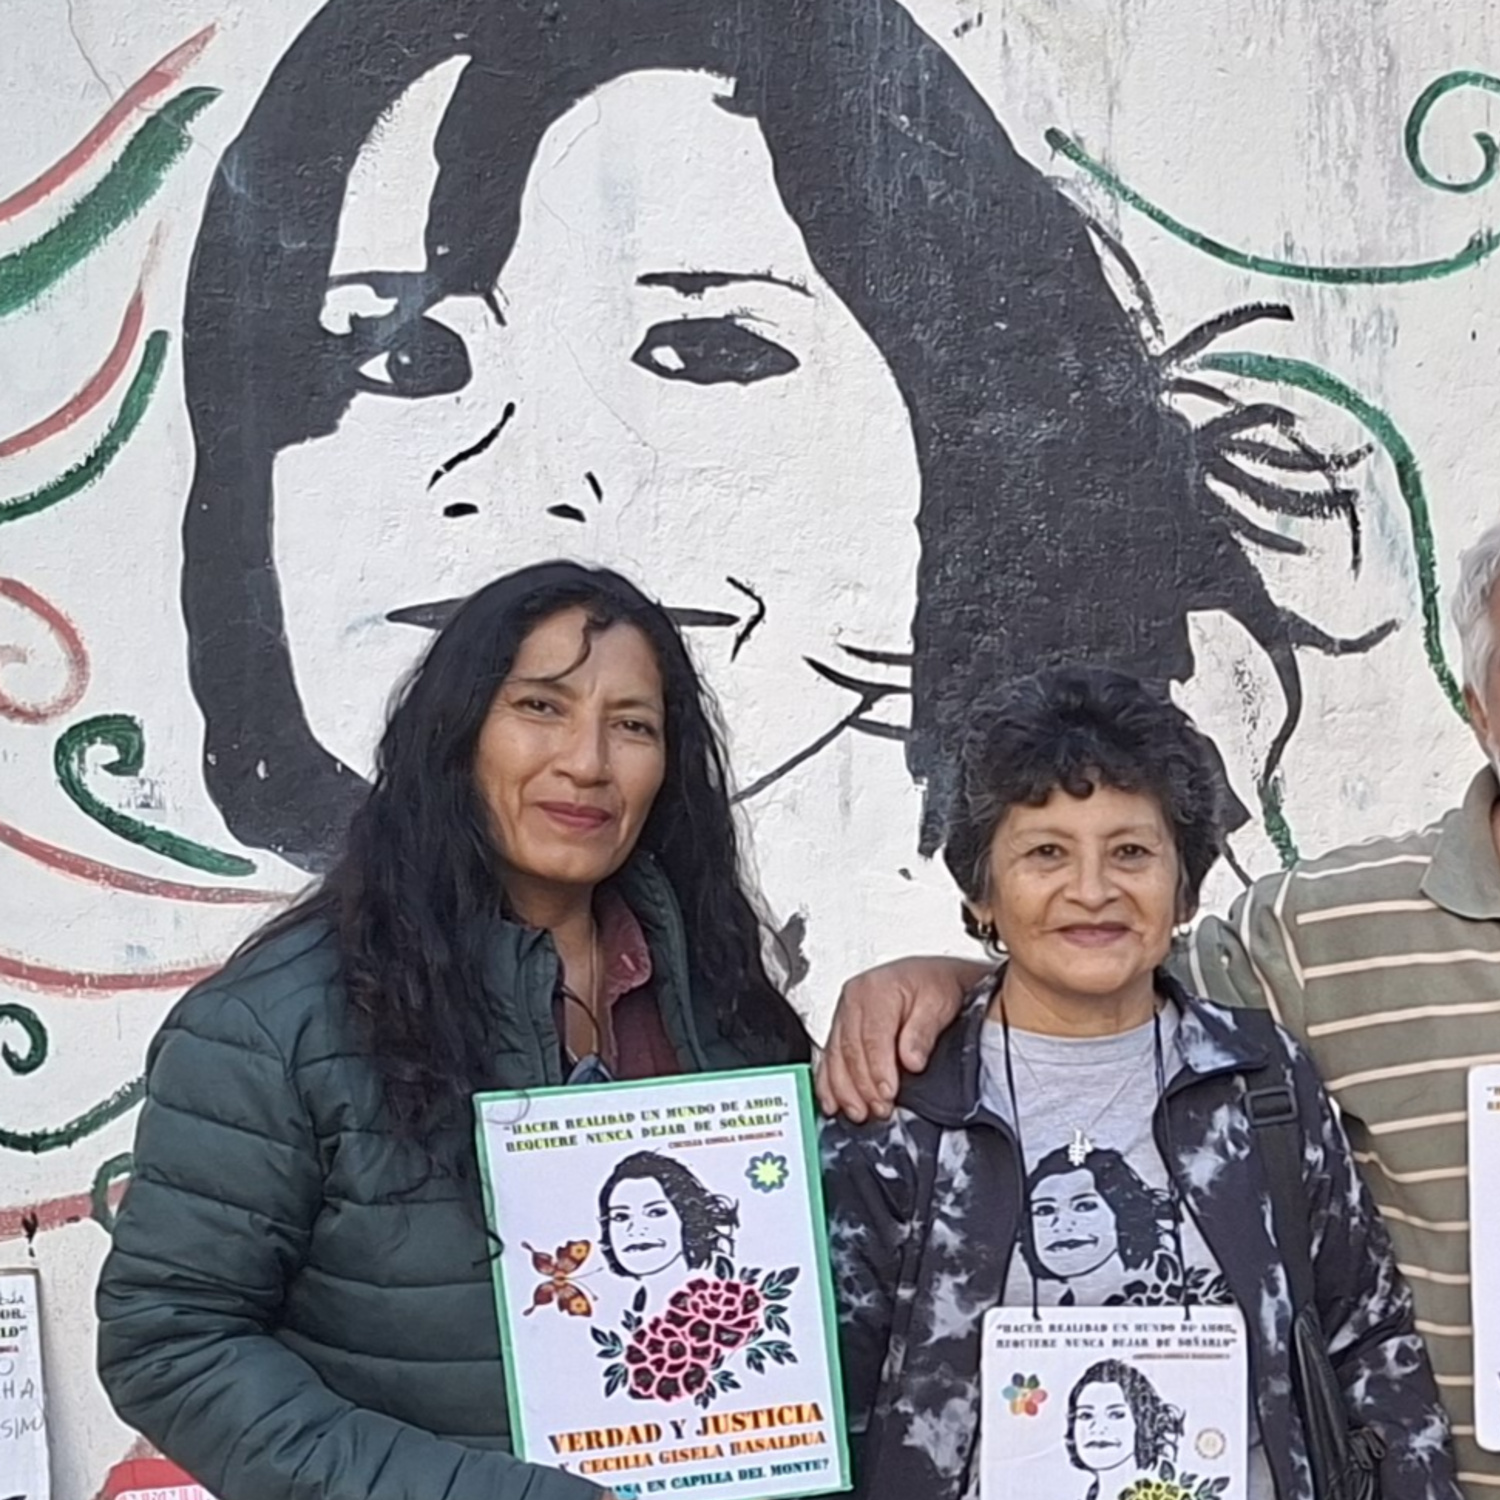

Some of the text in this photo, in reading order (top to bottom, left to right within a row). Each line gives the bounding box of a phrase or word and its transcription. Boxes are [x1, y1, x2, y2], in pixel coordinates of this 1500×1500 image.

[565, 1113, 635, 1130] REALIDAD
[641, 1109, 660, 1122] UN
[666, 1103, 715, 1119] MUNDO
[721, 1100, 740, 1113] DE
[506, 1136, 577, 1152] REQUIERE
[586, 1130, 633, 1144] NUNCA
[641, 1124, 686, 1138] DEJAR
[694, 1120, 712, 1132] DE
[1049, 1323, 1108, 1333] REALIDAD
[1065, 1339, 1104, 1348] NUNCA
[1112, 1338, 1148, 1348] DEJAR
[1156, 1338, 1171, 1348] DE
[548, 1402, 824, 1454] VERDAD Y JUSTICIA
[580, 1453, 654, 1475] CECILIA
[659, 1447, 725, 1465] GISELA
[730, 1431, 826, 1456] BASALDUA
[647, 1479, 666, 1492] EN
[671, 1471, 733, 1490] CAPILLA
[738, 1467, 766, 1481] DEL
[770, 1458, 829, 1477] MONTE?
